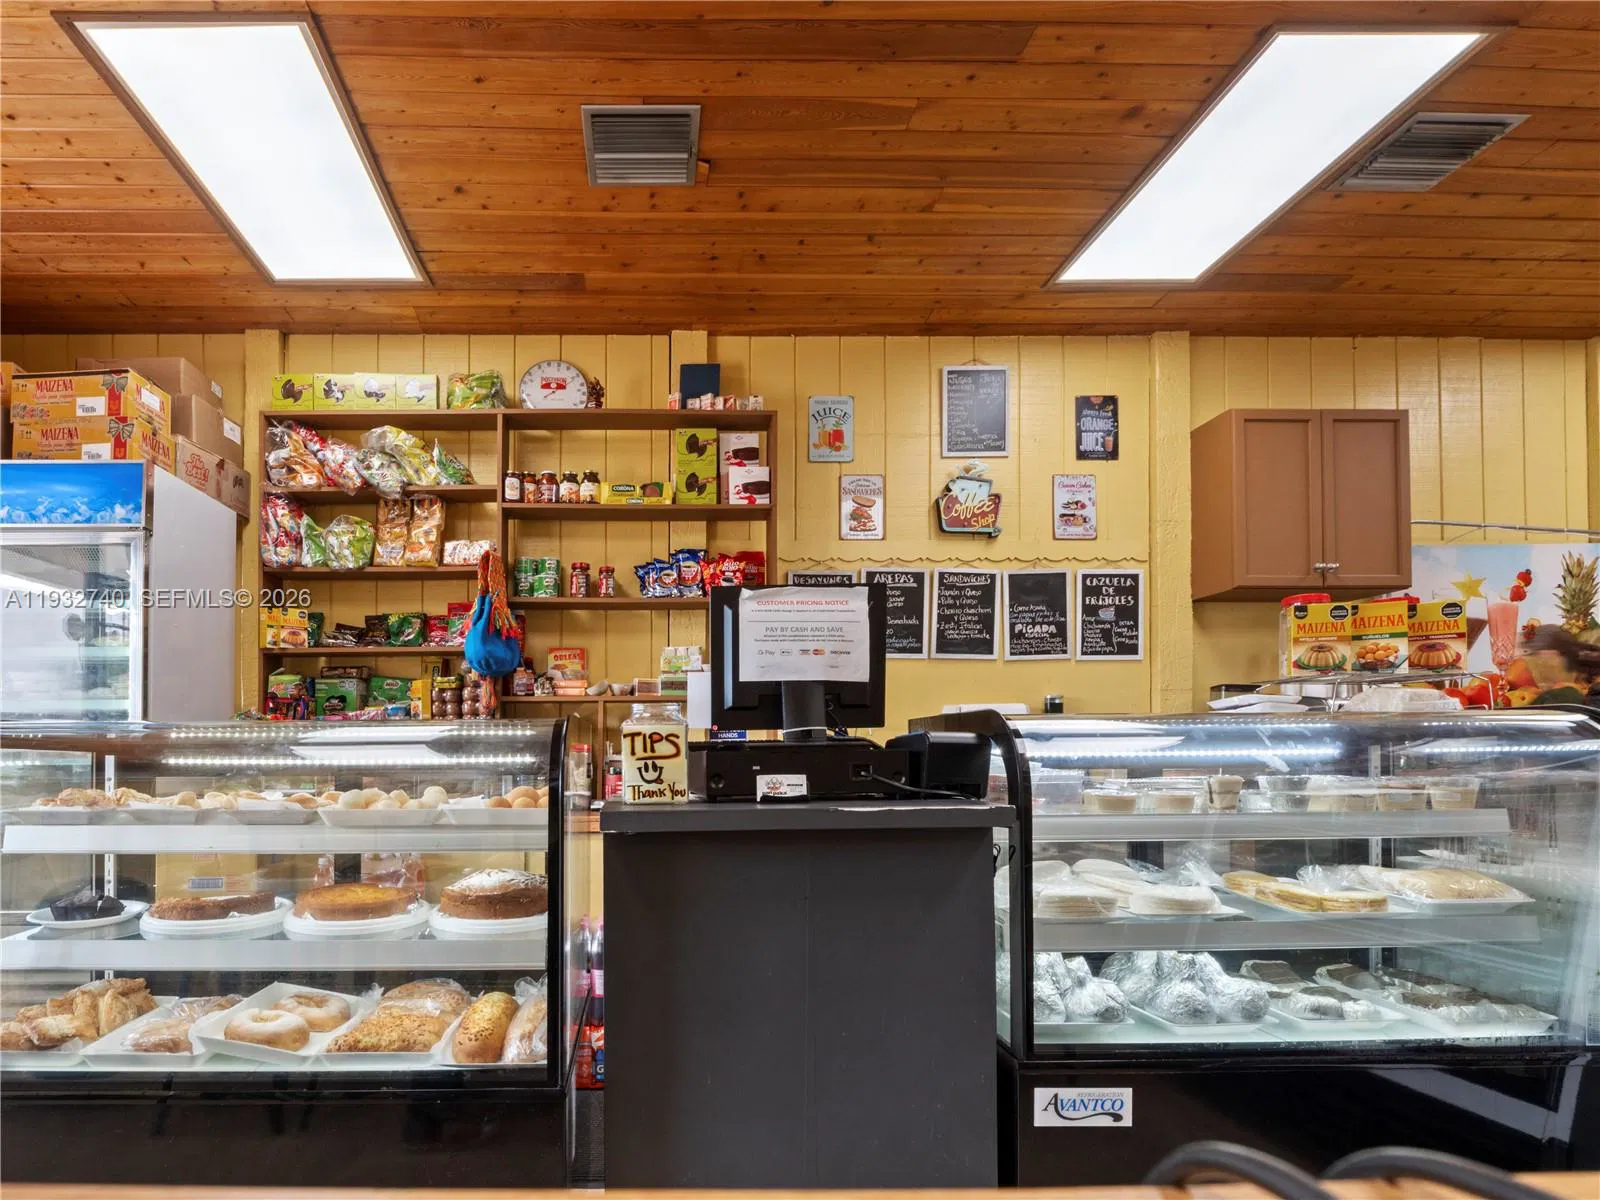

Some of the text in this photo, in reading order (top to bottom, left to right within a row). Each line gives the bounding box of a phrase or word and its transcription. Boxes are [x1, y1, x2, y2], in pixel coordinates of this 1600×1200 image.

[36, 379, 74, 393] MAIZENA
[811, 407, 851, 424] JUICE
[1080, 418, 1115, 431] ORANGE
[41, 427, 79, 441] MAIZENA
[142, 431, 171, 460] MAIZENA
[1080, 432, 1105, 452] JUICE
[842, 487, 882, 496] SANDWICHES
[941, 492, 995, 520] Coffee
[970, 514, 996, 531] Shop
[793, 576, 850, 585] DESAYUNOS
[873, 573, 914, 584] AREPAS
[944, 574, 990, 584] SANDWICHES
[1086, 577, 1136, 587] CAZUELA
[1102, 587, 1116, 595] DE
[1296, 621, 1346, 634] MAIZENA
[623, 731, 682, 758] TIPS
[627, 782, 686, 801] Thank You
[1042, 1092, 1124, 1122] AVANTCO
